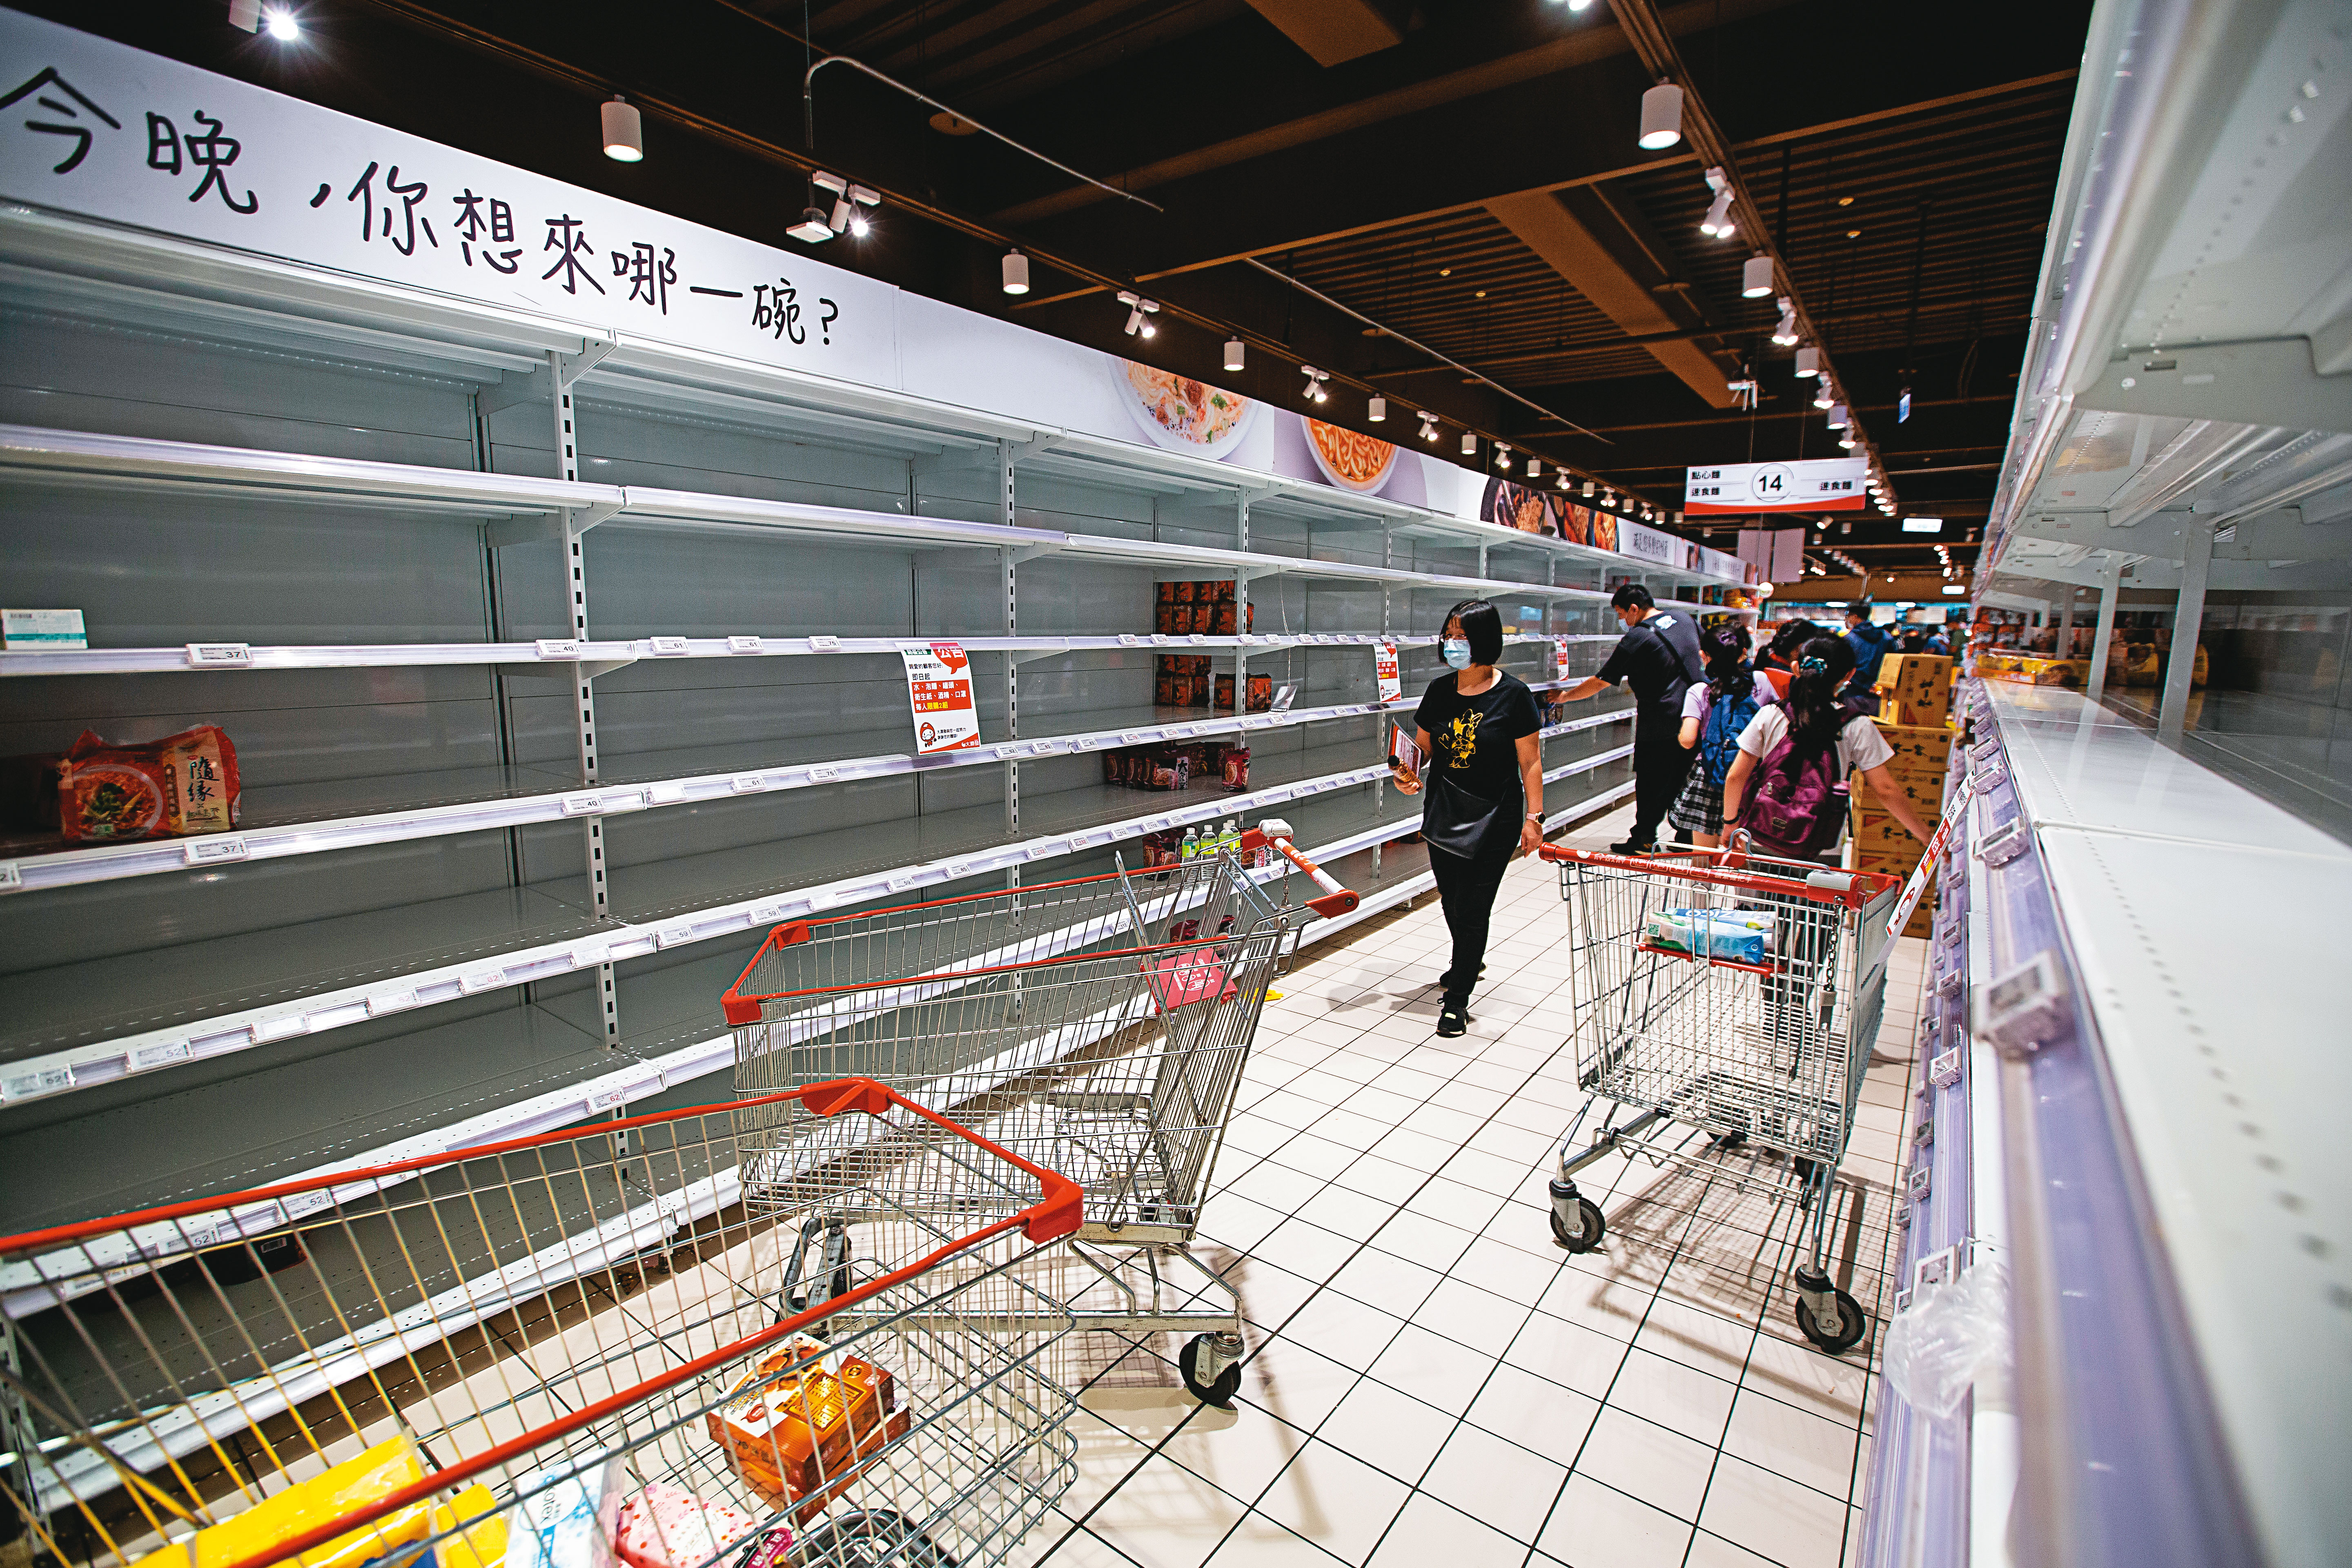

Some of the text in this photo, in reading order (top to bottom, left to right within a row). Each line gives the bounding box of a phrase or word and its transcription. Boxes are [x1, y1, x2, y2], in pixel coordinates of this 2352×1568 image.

[1691, 470, 1721, 480] 點心麵
[1759, 474, 1783, 492] 14
[1819, 481, 1853, 491] 速食麵
[1691, 486, 1721, 496] 速食麵
[187, 757, 220, 802] 隨緣
[166, 1049, 181, 1058] 52
[310, 1196, 324, 1205] 52
[194, 1235, 209, 1245] 52
